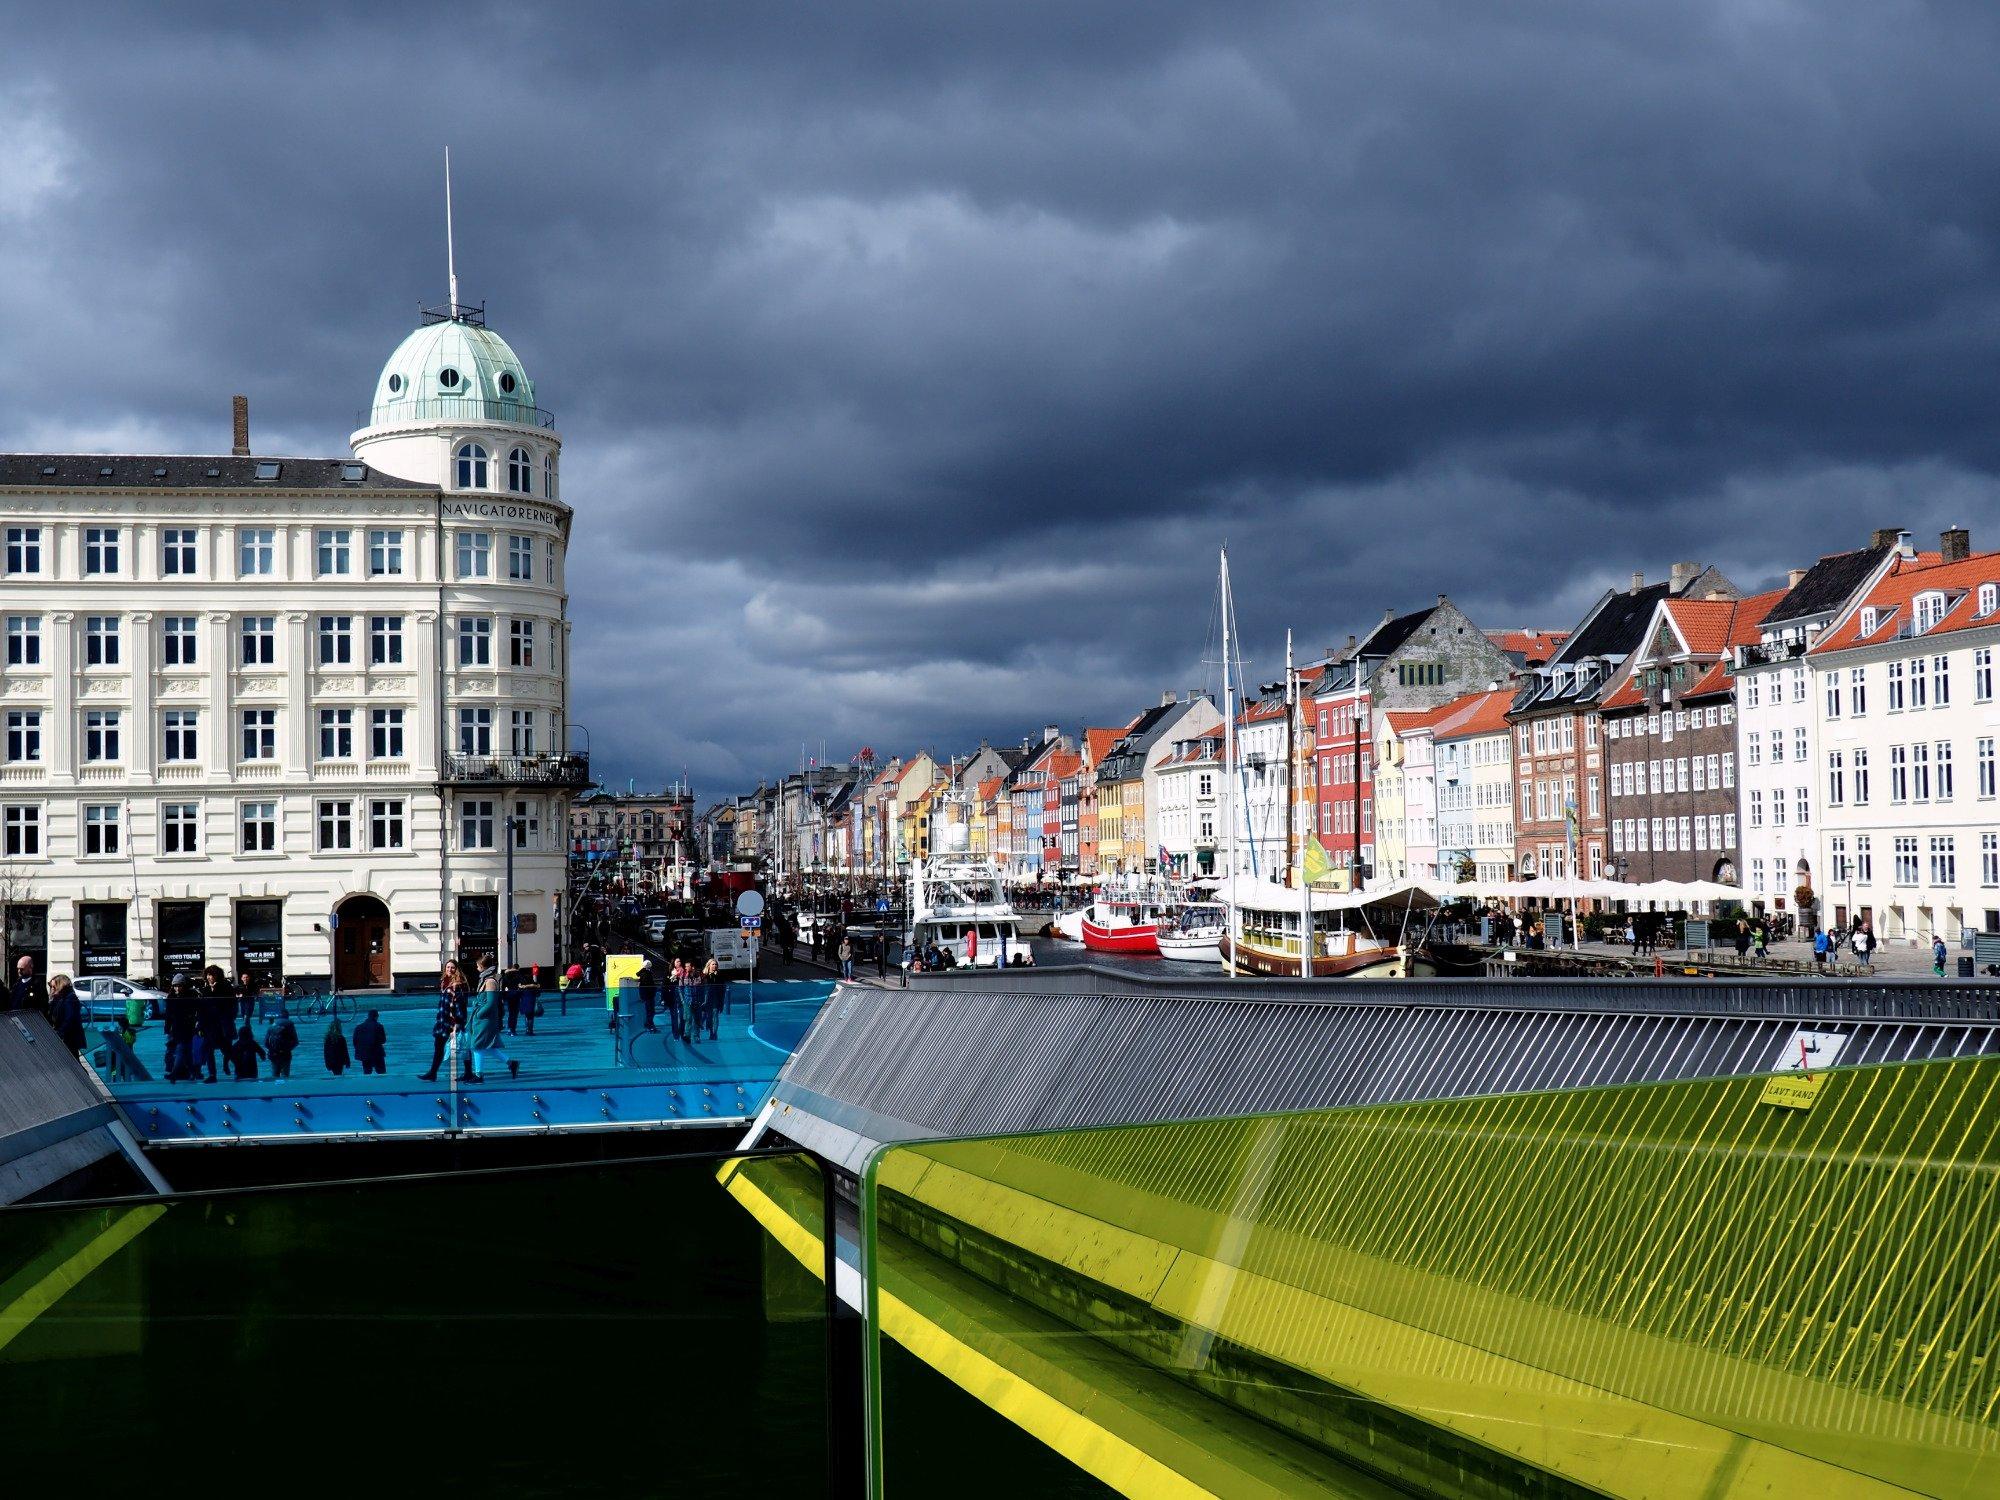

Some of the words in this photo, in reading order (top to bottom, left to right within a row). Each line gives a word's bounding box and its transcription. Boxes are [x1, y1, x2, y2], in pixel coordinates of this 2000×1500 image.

[442, 503, 553, 525] NAVIGATØRERNES
[1768, 1086, 1790, 1096] LAVT
[1792, 1089, 1814, 1100] VAND
